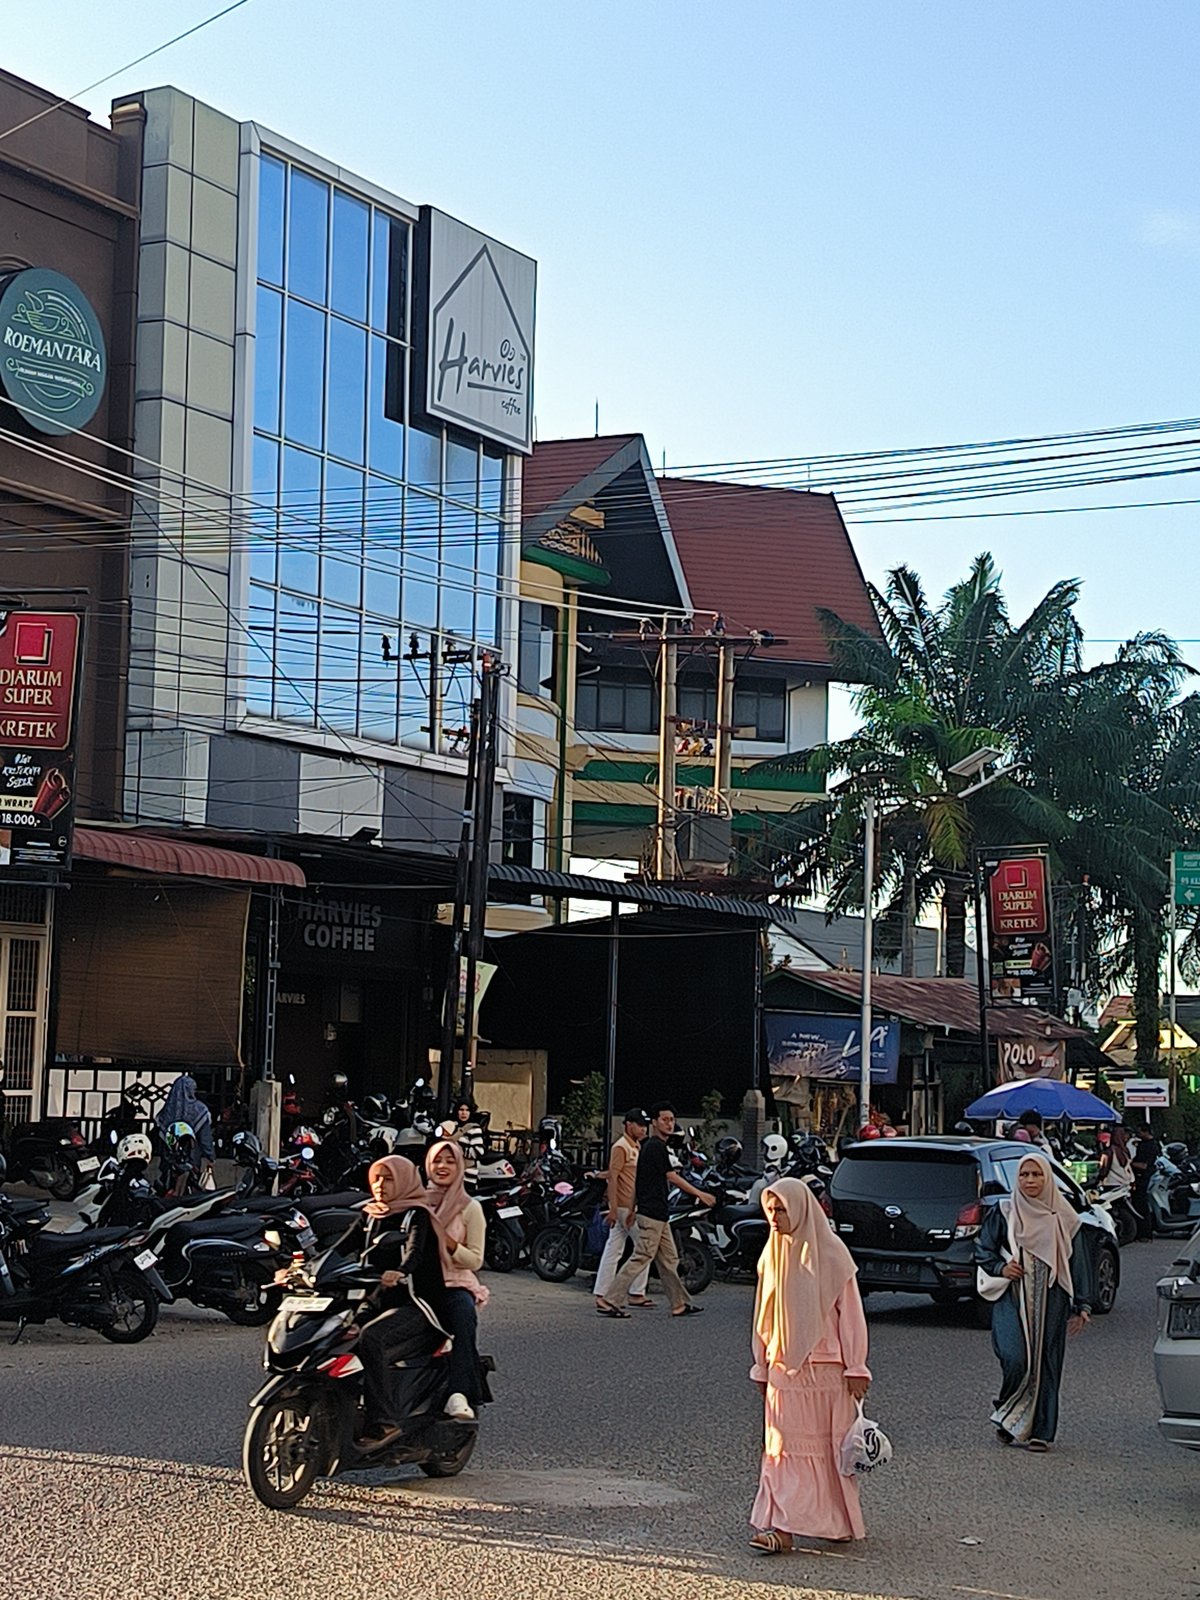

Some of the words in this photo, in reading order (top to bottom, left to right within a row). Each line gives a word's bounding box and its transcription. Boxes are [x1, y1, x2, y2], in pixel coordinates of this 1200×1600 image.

[4, 326, 101, 372] ROEMANTARA
[437, 317, 524, 402] Harvies
[501, 397, 521, 416] coffee
[0, 668, 62, 687] DJARUM
[4, 688, 53, 705] SUPER
[5, 798, 33, 808] WRAPS
[998, 890, 1037, 901] DJARUM
[298, 897, 382, 927] HARVIES
[1003, 901, 1034, 911] SUPER
[1000, 918, 1038, 929] KRETEK
[304, 923, 375, 951] COFFEE
[276, 992, 306, 1004] ARVIES
[799, 1033, 820, 1041] NEW
